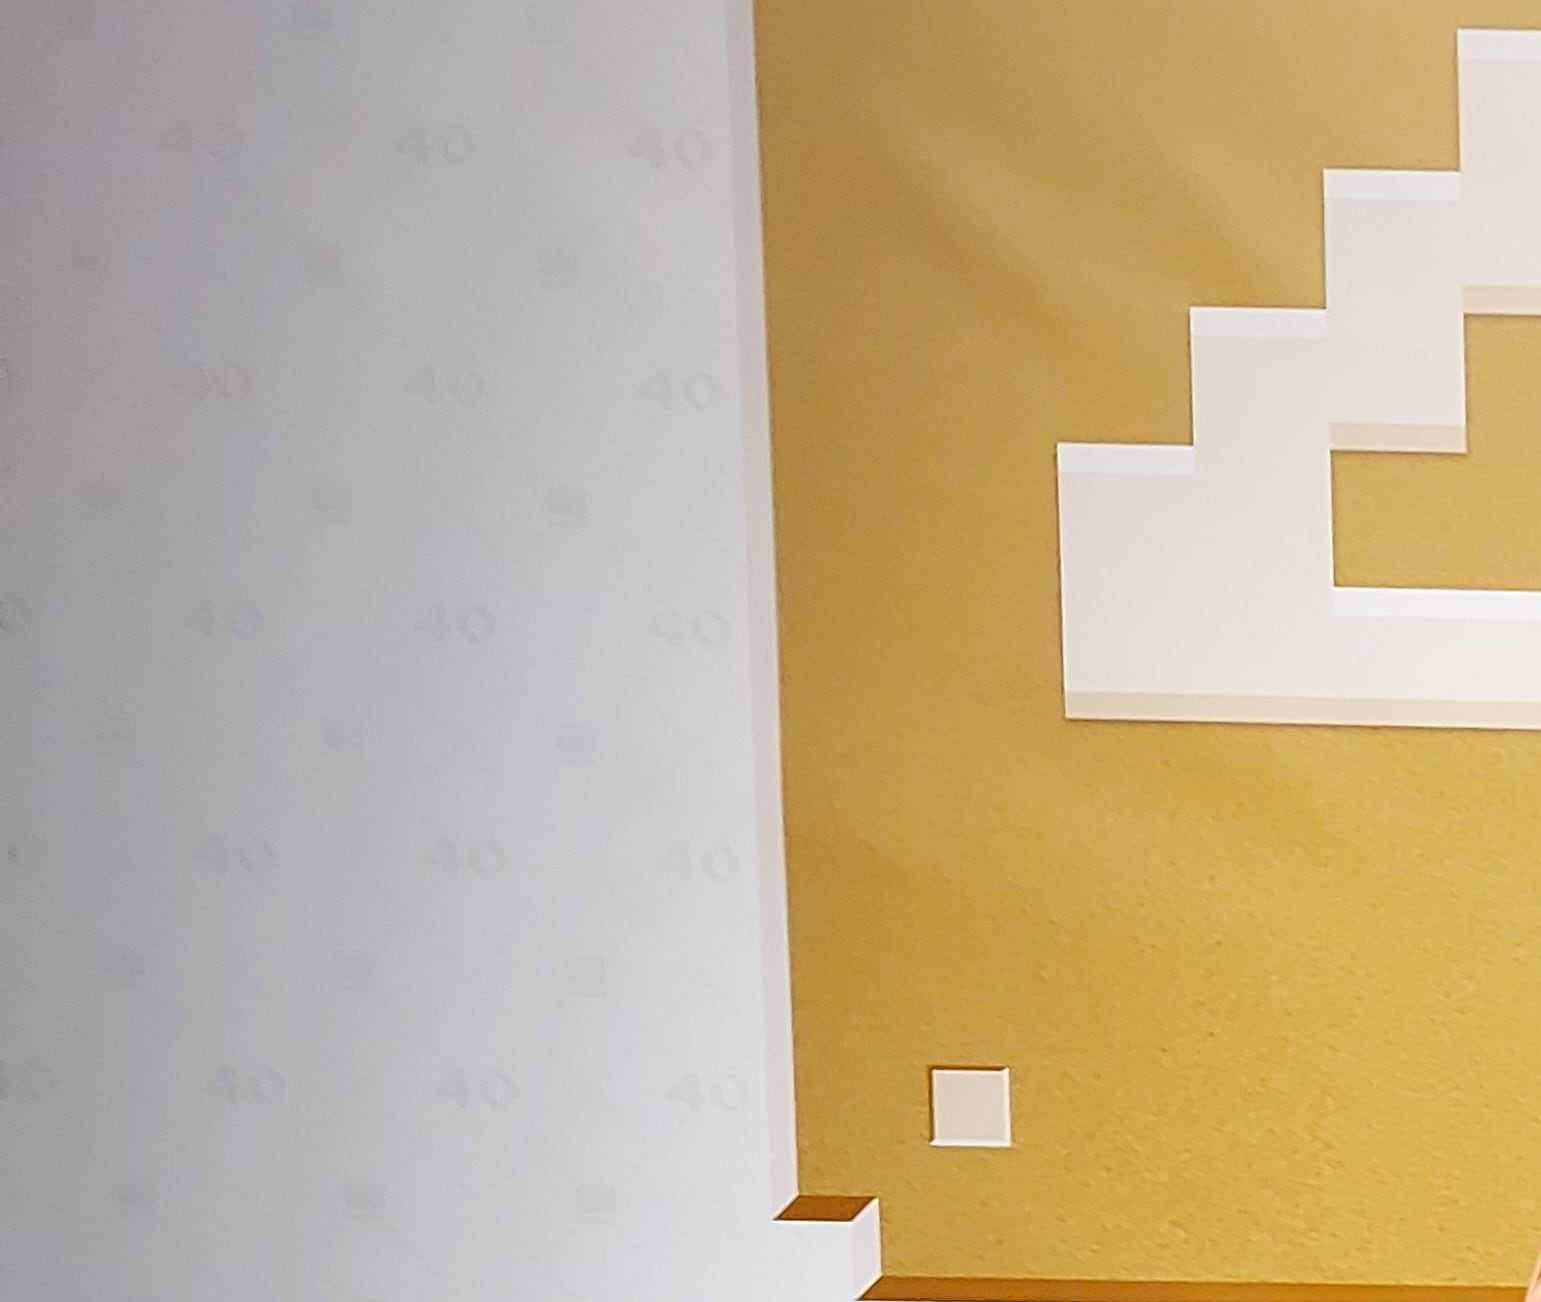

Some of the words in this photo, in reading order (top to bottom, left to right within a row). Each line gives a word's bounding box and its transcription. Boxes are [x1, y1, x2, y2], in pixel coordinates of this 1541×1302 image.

[160, 120, 243, 162] 40
[395, 124, 478, 166] 40
[629, 127, 712, 169] 40
[172, 361, 255, 403] 40
[404, 364, 487, 406] 40
[639, 369, 722, 411] 40
[182, 598, 265, 640] 40
[414, 602, 497, 644] 40
[647, 606, 730, 648] 40
[193, 833, 276, 875] 40
[425, 837, 508, 879] 40
[657, 841, 740, 883] 40
[204, 1064, 287, 1106] 40
[436, 1068, 519, 1110] 40
[666, 1071, 749, 1113] 40
